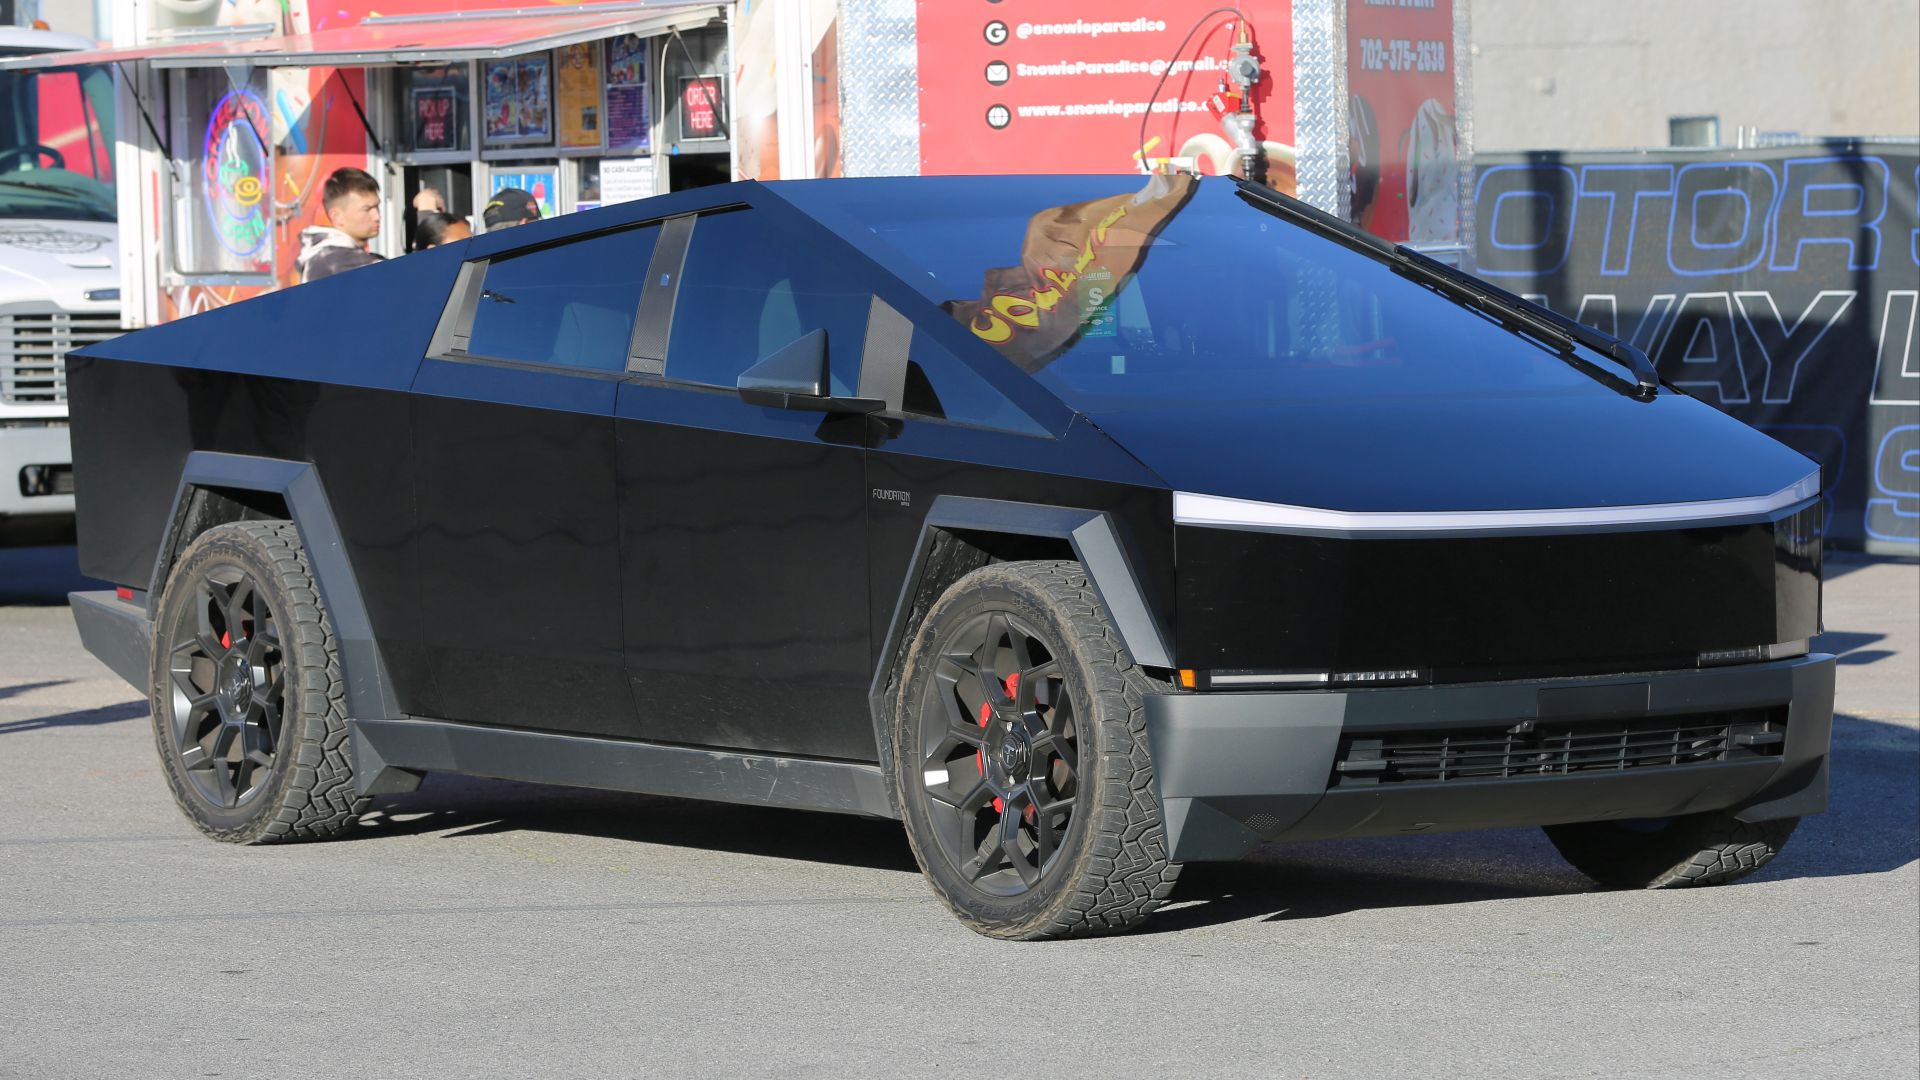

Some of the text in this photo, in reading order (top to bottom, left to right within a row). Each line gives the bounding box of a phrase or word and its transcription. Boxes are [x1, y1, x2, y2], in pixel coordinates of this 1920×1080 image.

[1360, 38, 1446, 72] 702-375-2638
[438, 98, 450, 118] UP
[690, 110, 714, 129] HERE
[424, 122, 445, 140] HERE
[1088, 287, 1104, 306] S
[872, 488, 911, 502] FOUNDATION
